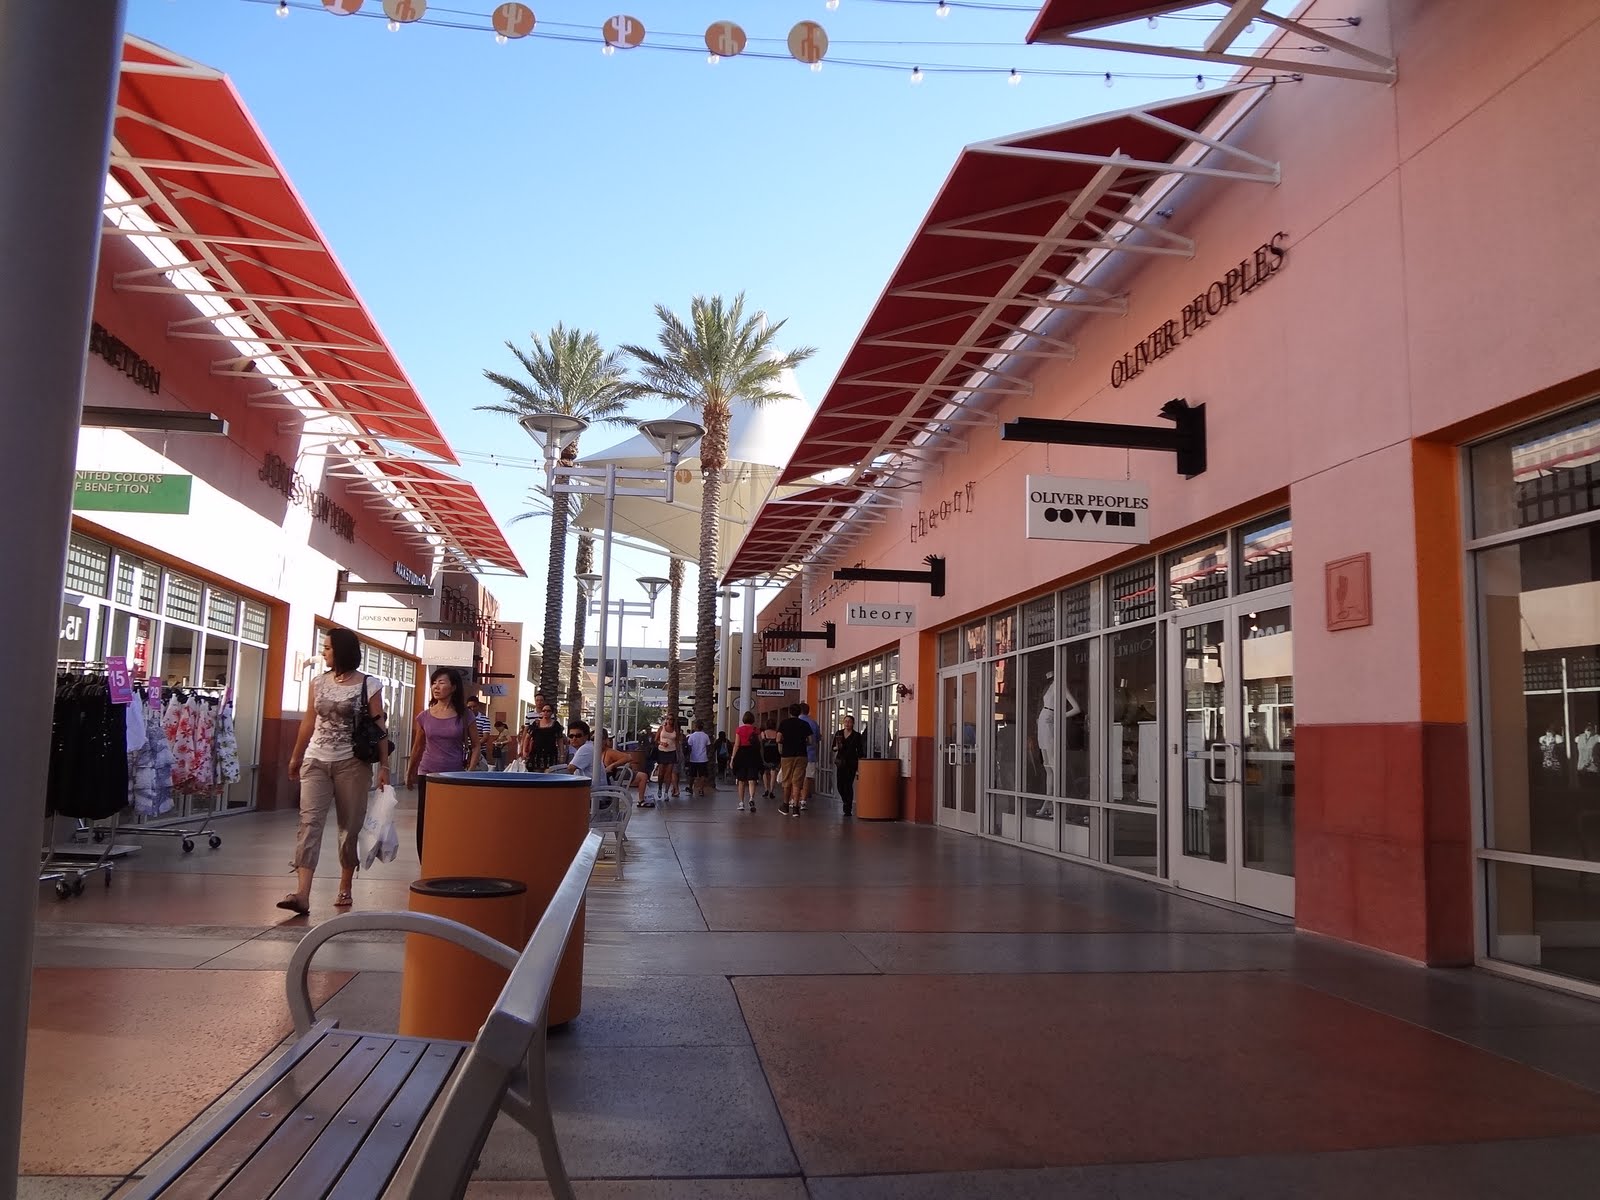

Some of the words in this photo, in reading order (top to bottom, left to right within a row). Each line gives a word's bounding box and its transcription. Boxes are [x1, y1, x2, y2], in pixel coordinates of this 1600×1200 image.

[1111, 317, 1178, 389] OLIVER
[1181, 231, 1288, 340] PEOPLES
[75, 470, 111, 482] NITED
[114, 472, 163, 484] COLORS
[84, 481, 152, 495] BENETTON.
[1030, 490, 1085, 506] OLIVER
[1087, 494, 1149, 510] PEOPLES
[910, 480, 977, 544] theory
[851, 605, 913, 624] theory
[110, 670, 126, 688] 15
[150, 686, 160, 699] 29
